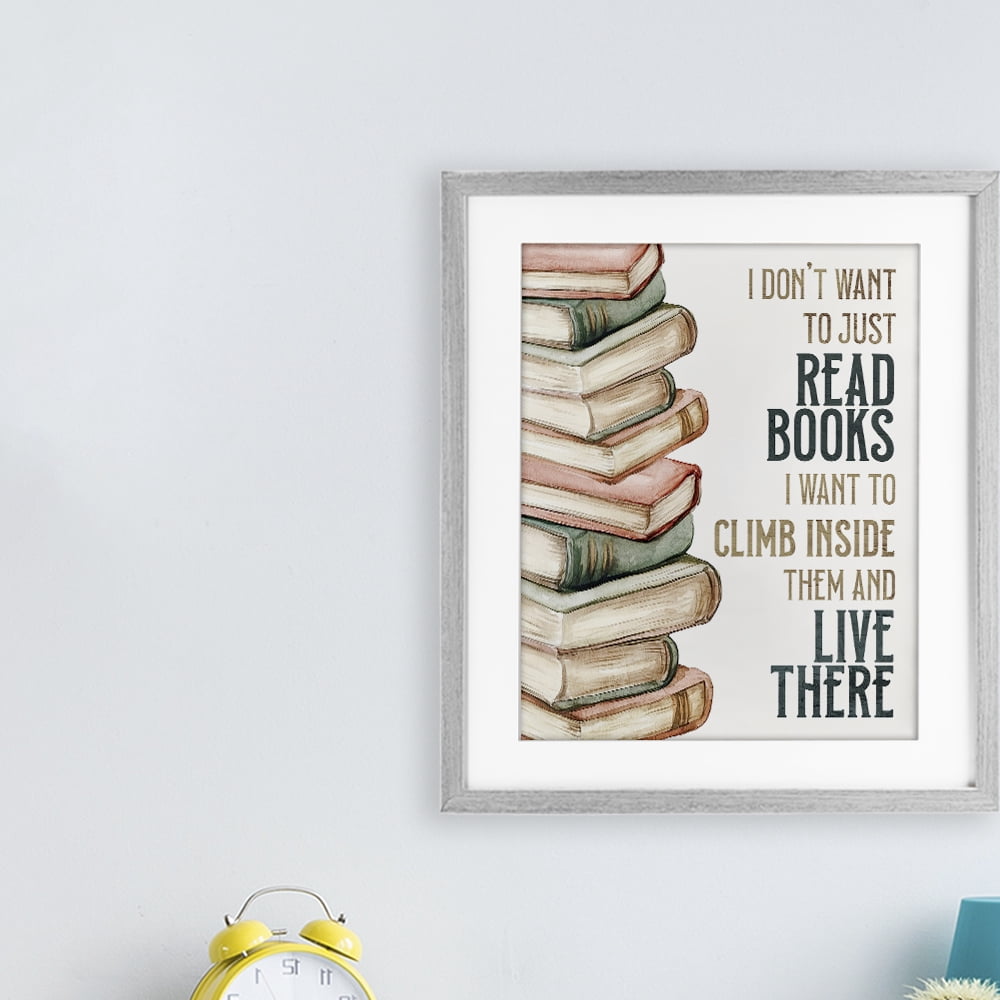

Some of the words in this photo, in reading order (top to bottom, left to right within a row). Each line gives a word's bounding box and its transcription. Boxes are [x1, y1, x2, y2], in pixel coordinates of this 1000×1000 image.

[748, 268, 754, 300] I
[761, 262, 828, 300] DON'T
[834, 268, 897, 301] WANT
[802, 312, 832, 345] TO
[837, 312, 897, 345] JUST
[795, 352, 895, 407] READ
[766, 407, 895, 463] BOOKS
[785, 473, 791, 505] I
[798, 473, 861, 506] WANT
[867, 473, 896, 506] TO
[713, 519, 797, 558] CLIMB
[806, 519, 896, 558] INSIDE
[783, 568, 845, 601] THEM
[851, 569, 896, 601] AND
[813, 609, 895, 664] LIVE
[769, 664, 895, 719] THERE
